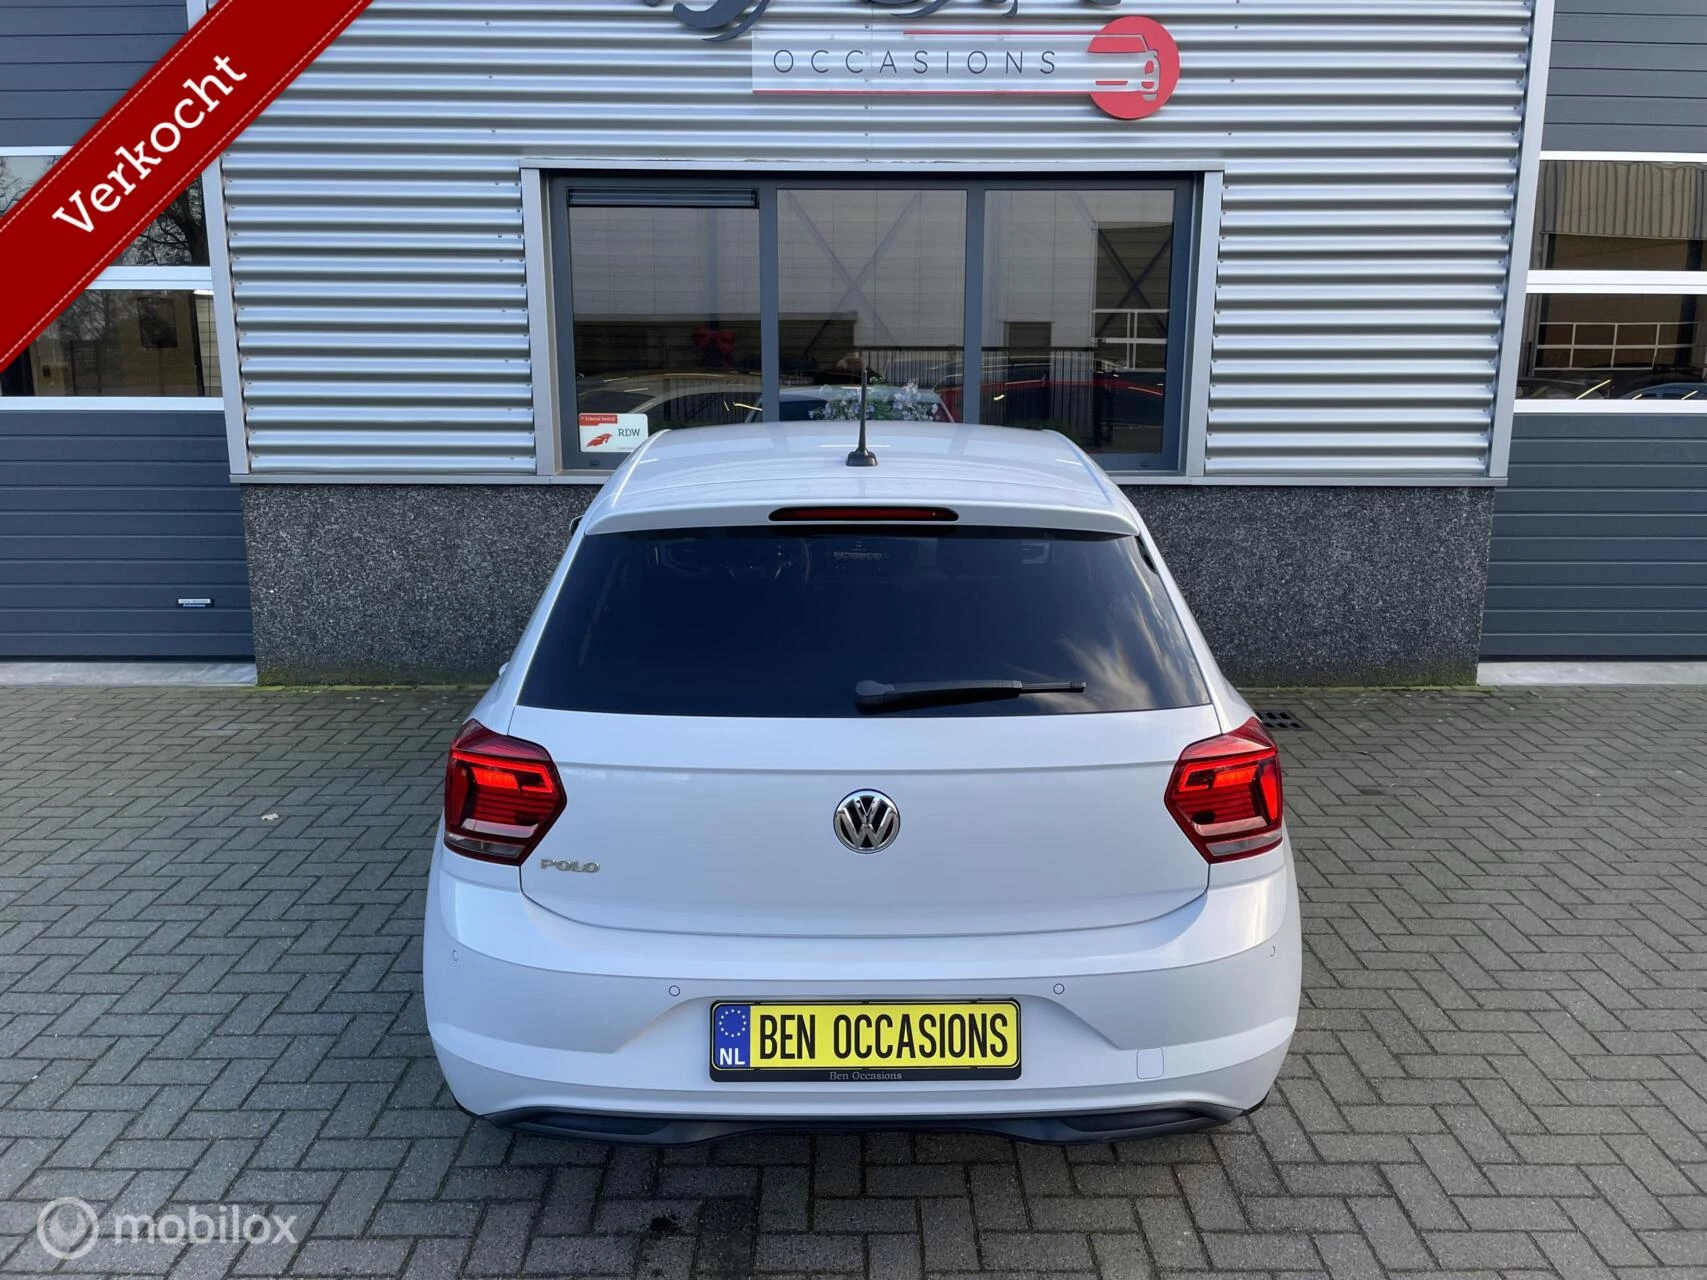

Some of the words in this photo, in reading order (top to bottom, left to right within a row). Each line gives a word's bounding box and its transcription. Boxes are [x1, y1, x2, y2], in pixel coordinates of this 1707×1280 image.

[773, 49, 1056, 75] OCCASIONS
[618, 428, 640, 437] RDW
[541, 859, 600, 873] POLO
[719, 1047, 746, 1066] NL
[759, 1014, 816, 1060] BEN
[833, 1013, 1009, 1059] OCCASIONS
[829, 1071, 849, 1080] Ben
[851, 1071, 903, 1080] Occasions
